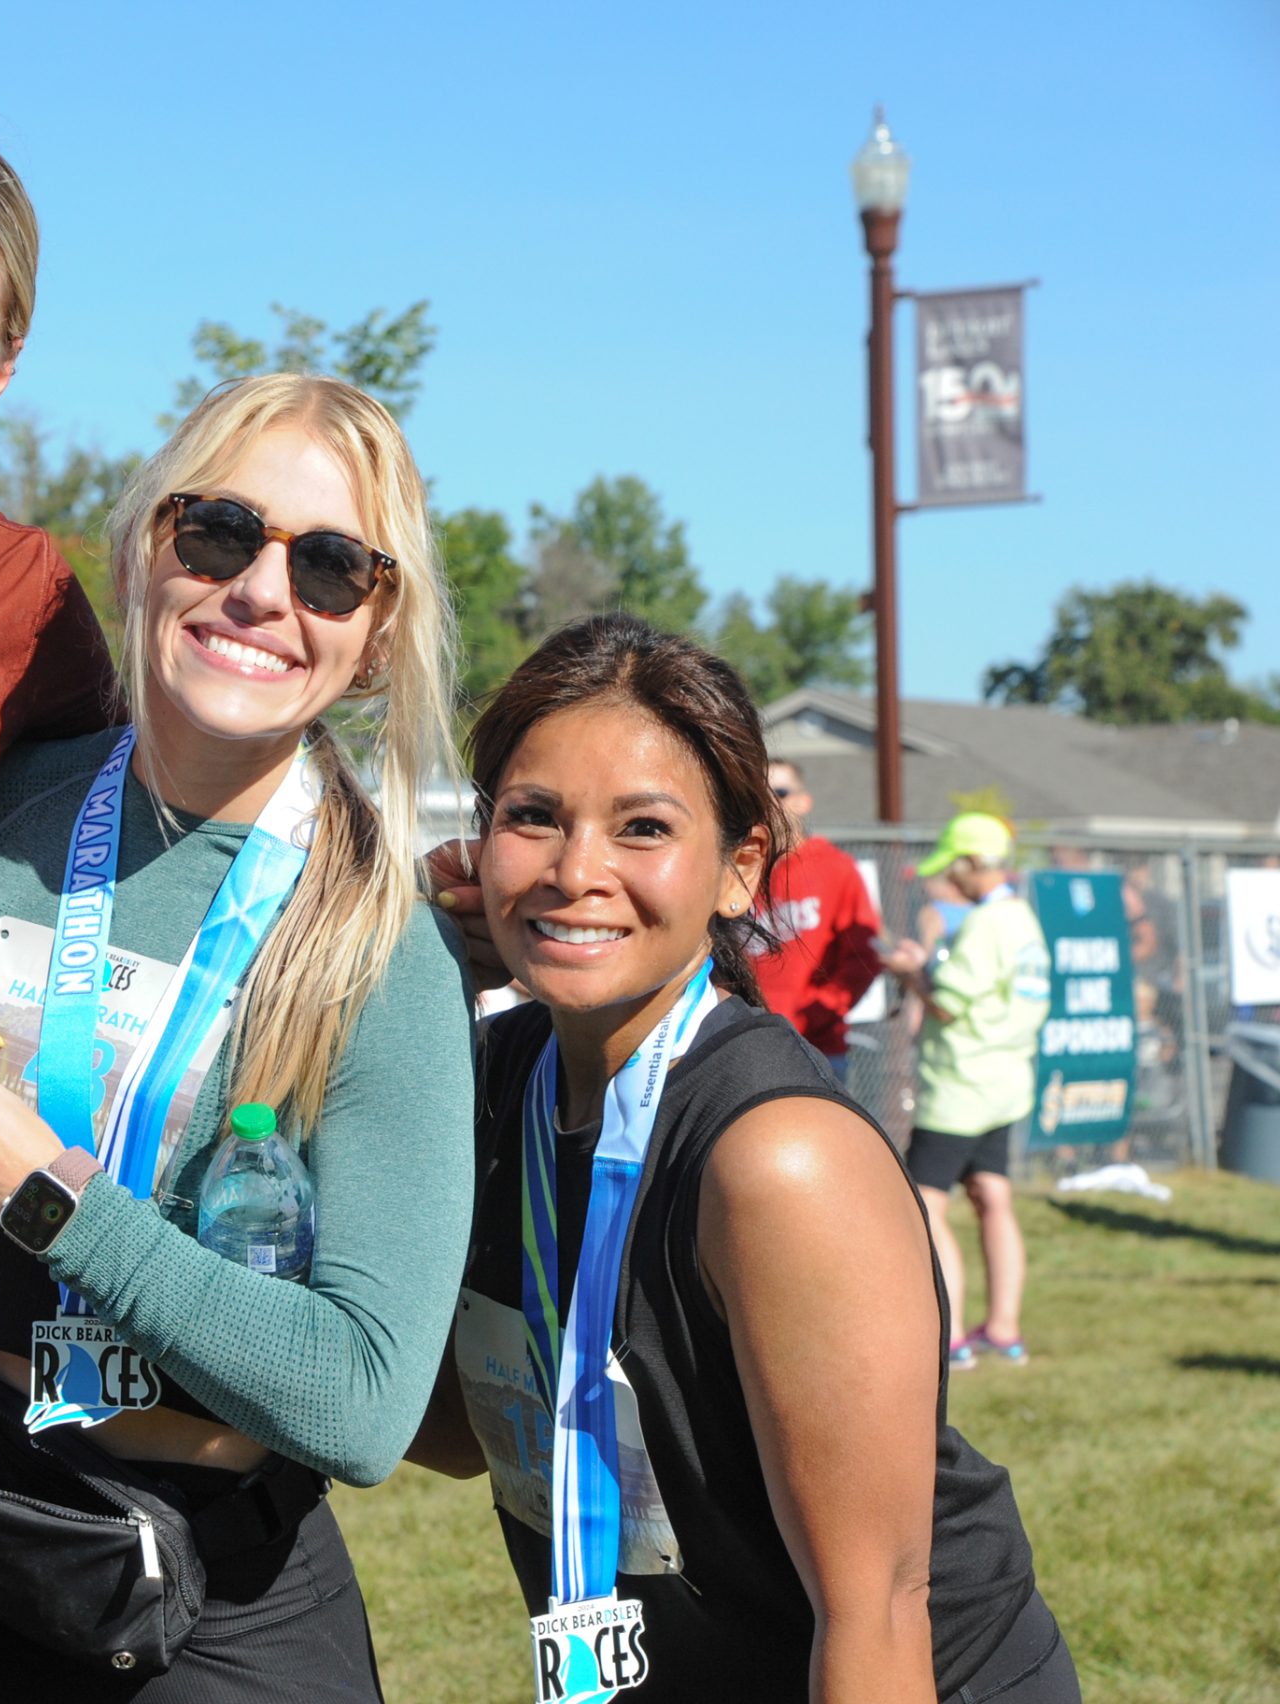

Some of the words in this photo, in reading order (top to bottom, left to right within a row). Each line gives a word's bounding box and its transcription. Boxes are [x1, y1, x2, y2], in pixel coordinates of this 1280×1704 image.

[54, 785, 117, 996] MARATHON
[640, 1052, 662, 1108] Essentia
[35, 1325, 72, 1341] DICK
[486, 1355, 520, 1383] HALF
[537, 1617, 568, 1635] DICK
[573, 1604, 640, 1629] BEARDSLEY
